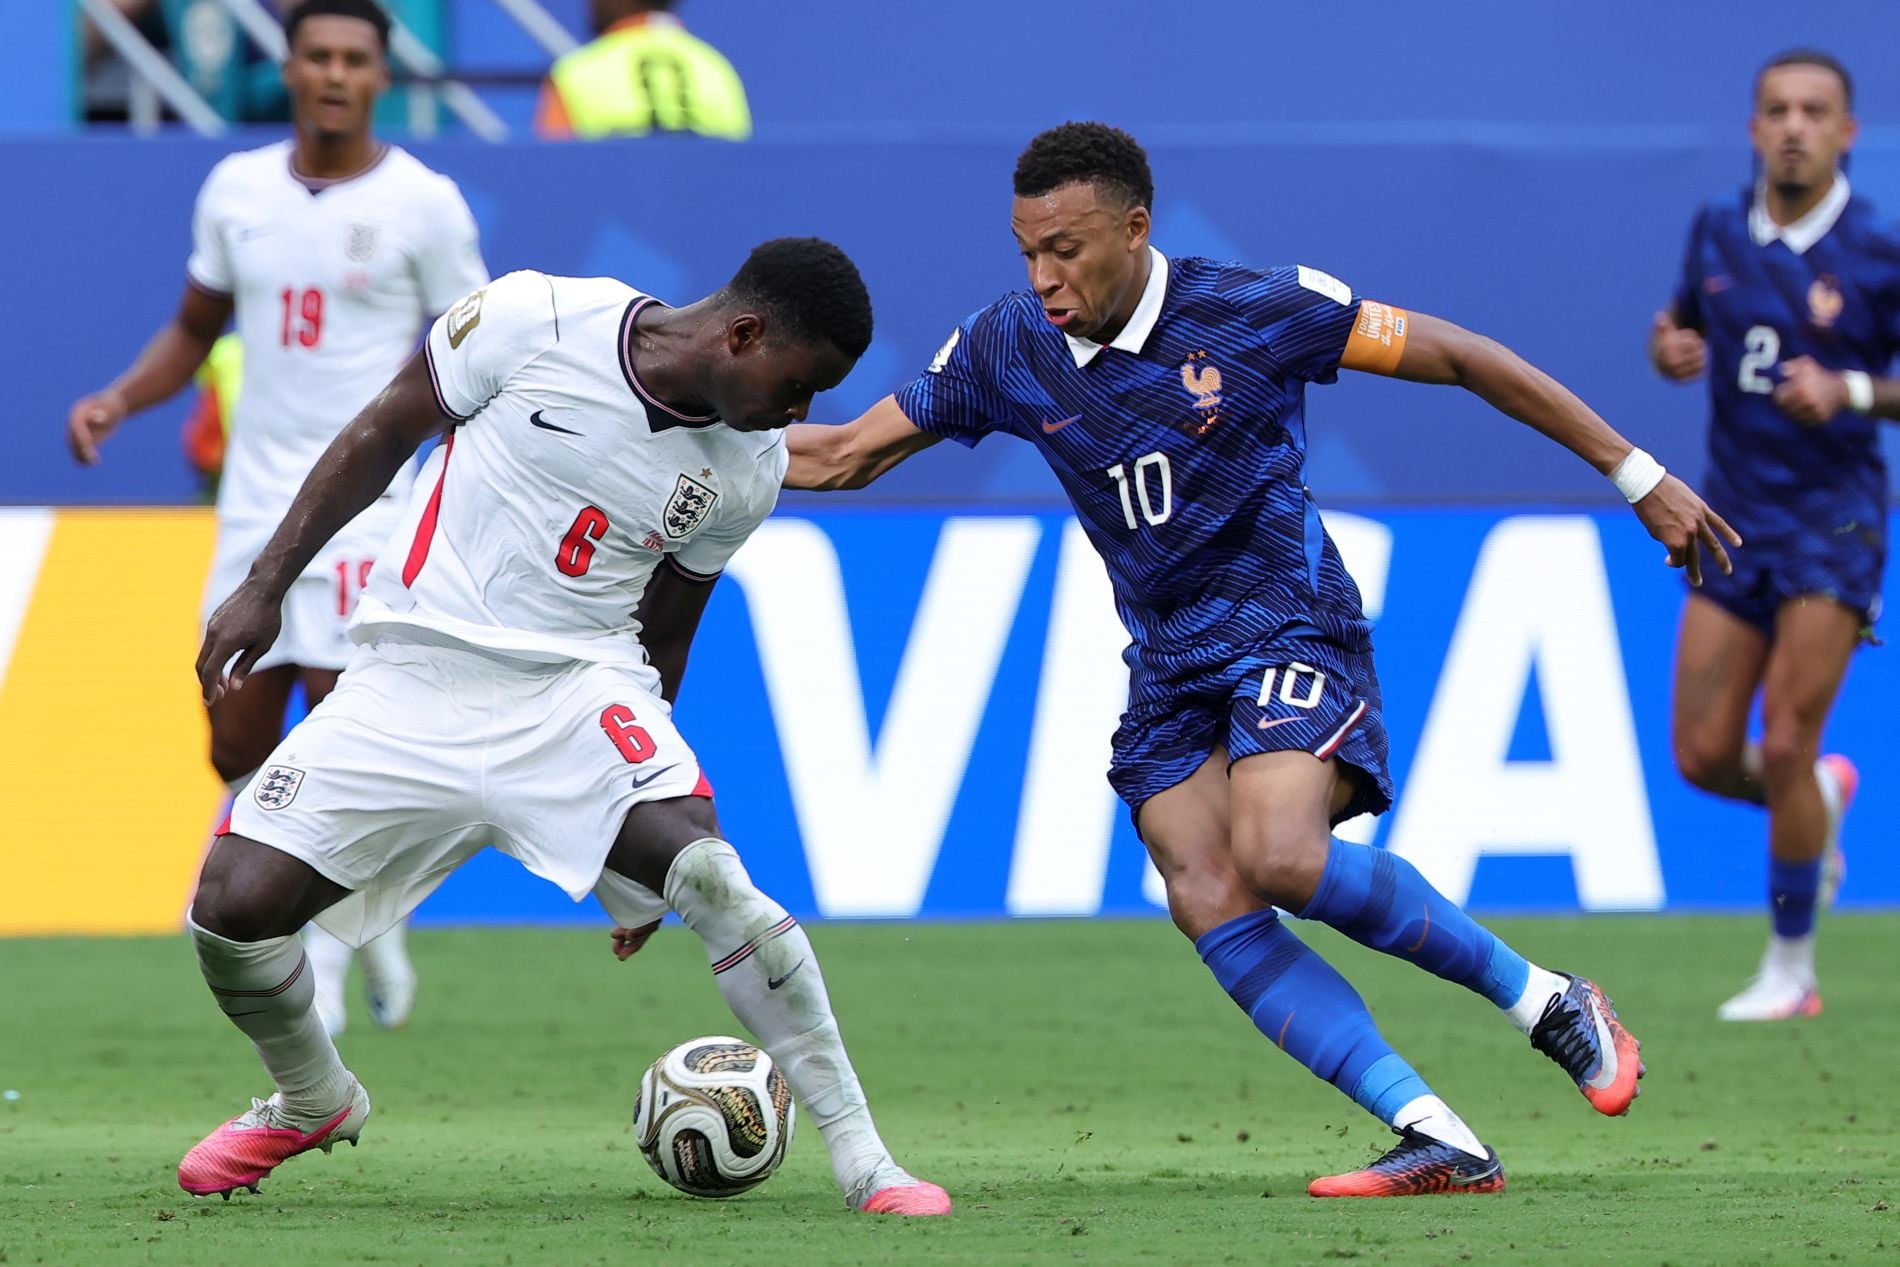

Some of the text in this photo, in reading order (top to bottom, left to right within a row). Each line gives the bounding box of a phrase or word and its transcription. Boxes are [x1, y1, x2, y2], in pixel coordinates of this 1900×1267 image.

[277, 287, 324, 348] 19
[1737, 324, 1780, 395] 2
[1106, 451, 1172, 530] 10
[554, 505, 610, 578] 6
[720, 512, 1667, 917] VIA
[1257, 661, 1325, 709] 10
[600, 703, 658, 764] 6
